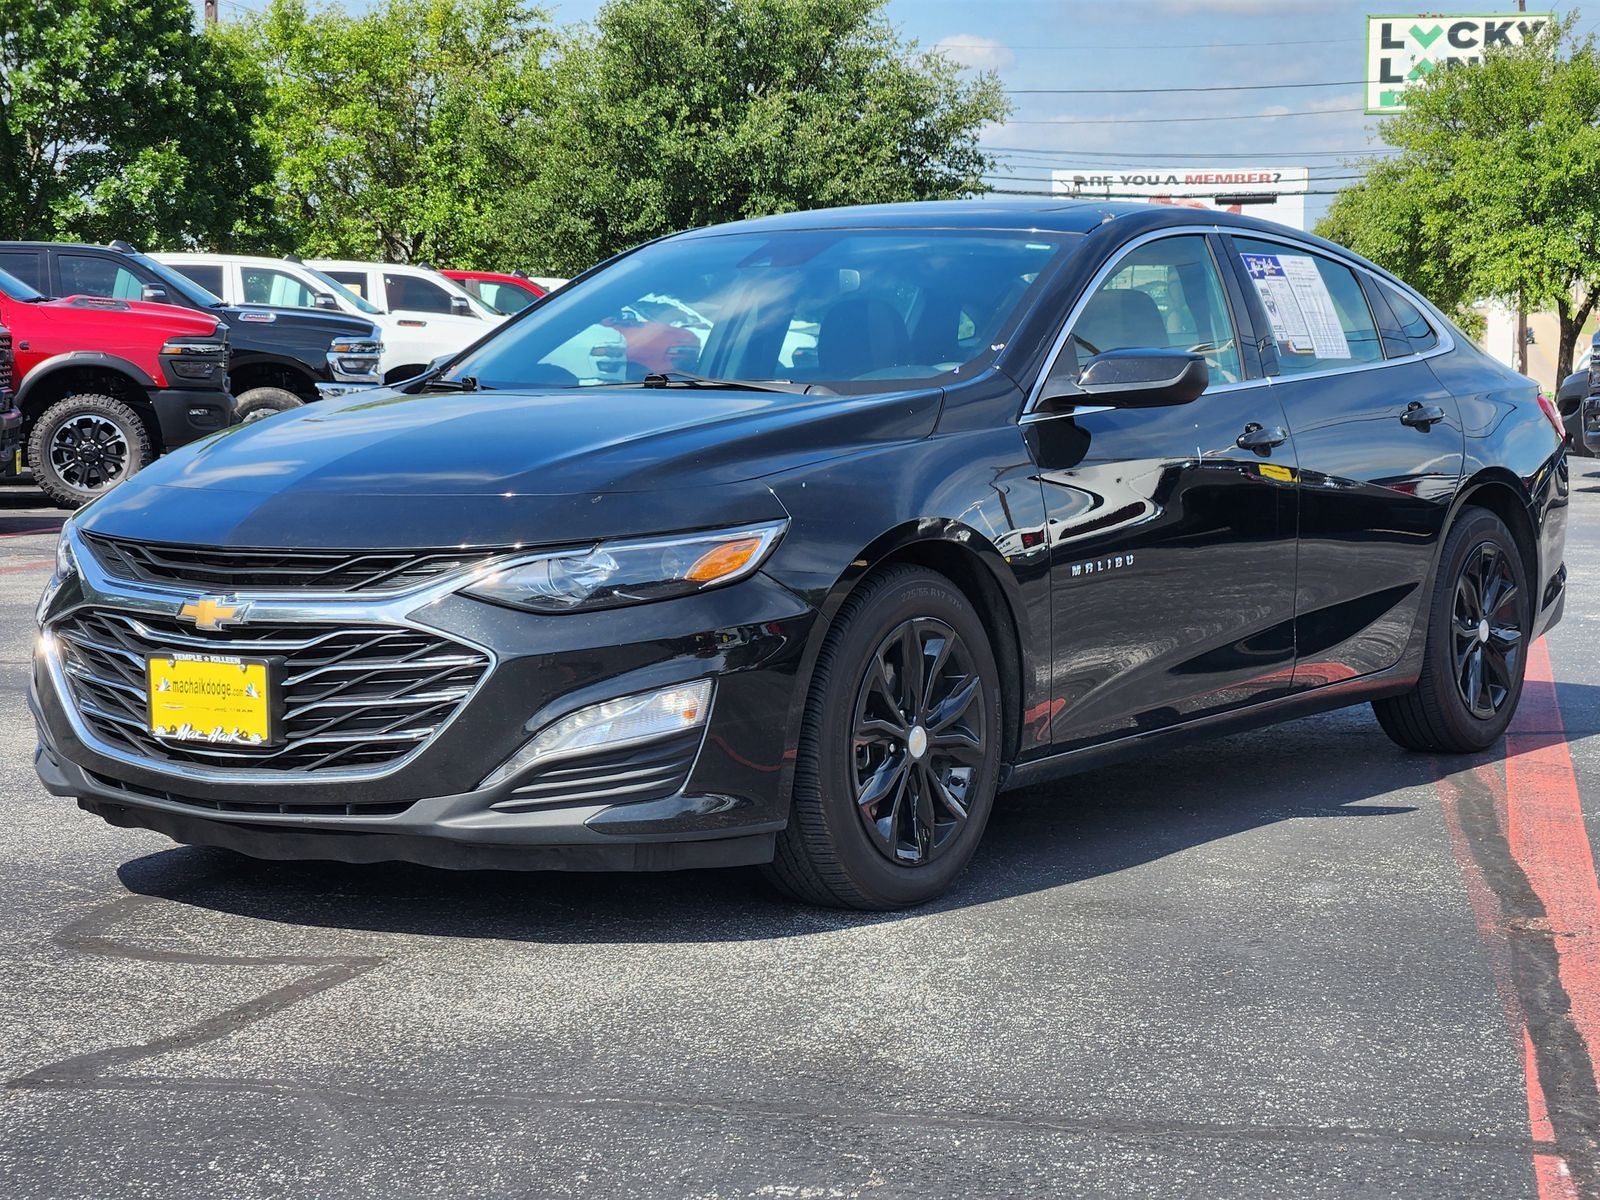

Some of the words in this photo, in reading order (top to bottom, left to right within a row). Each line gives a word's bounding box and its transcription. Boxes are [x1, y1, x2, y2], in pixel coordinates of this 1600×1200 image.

[1120, 175, 1160, 186] YOU
[1164, 175, 1179, 186] A
[1185, 173, 1281, 185] MEMBER?
[1071, 554, 1134, 576] MALIBU
[172, 653, 203, 662] TEMPLE
[210, 655, 241, 664] KILLEEN
[172, 677, 244, 700] machaikdodge.com
[177, 723, 206, 741] Mac
[206, 726, 241, 743] Haik
